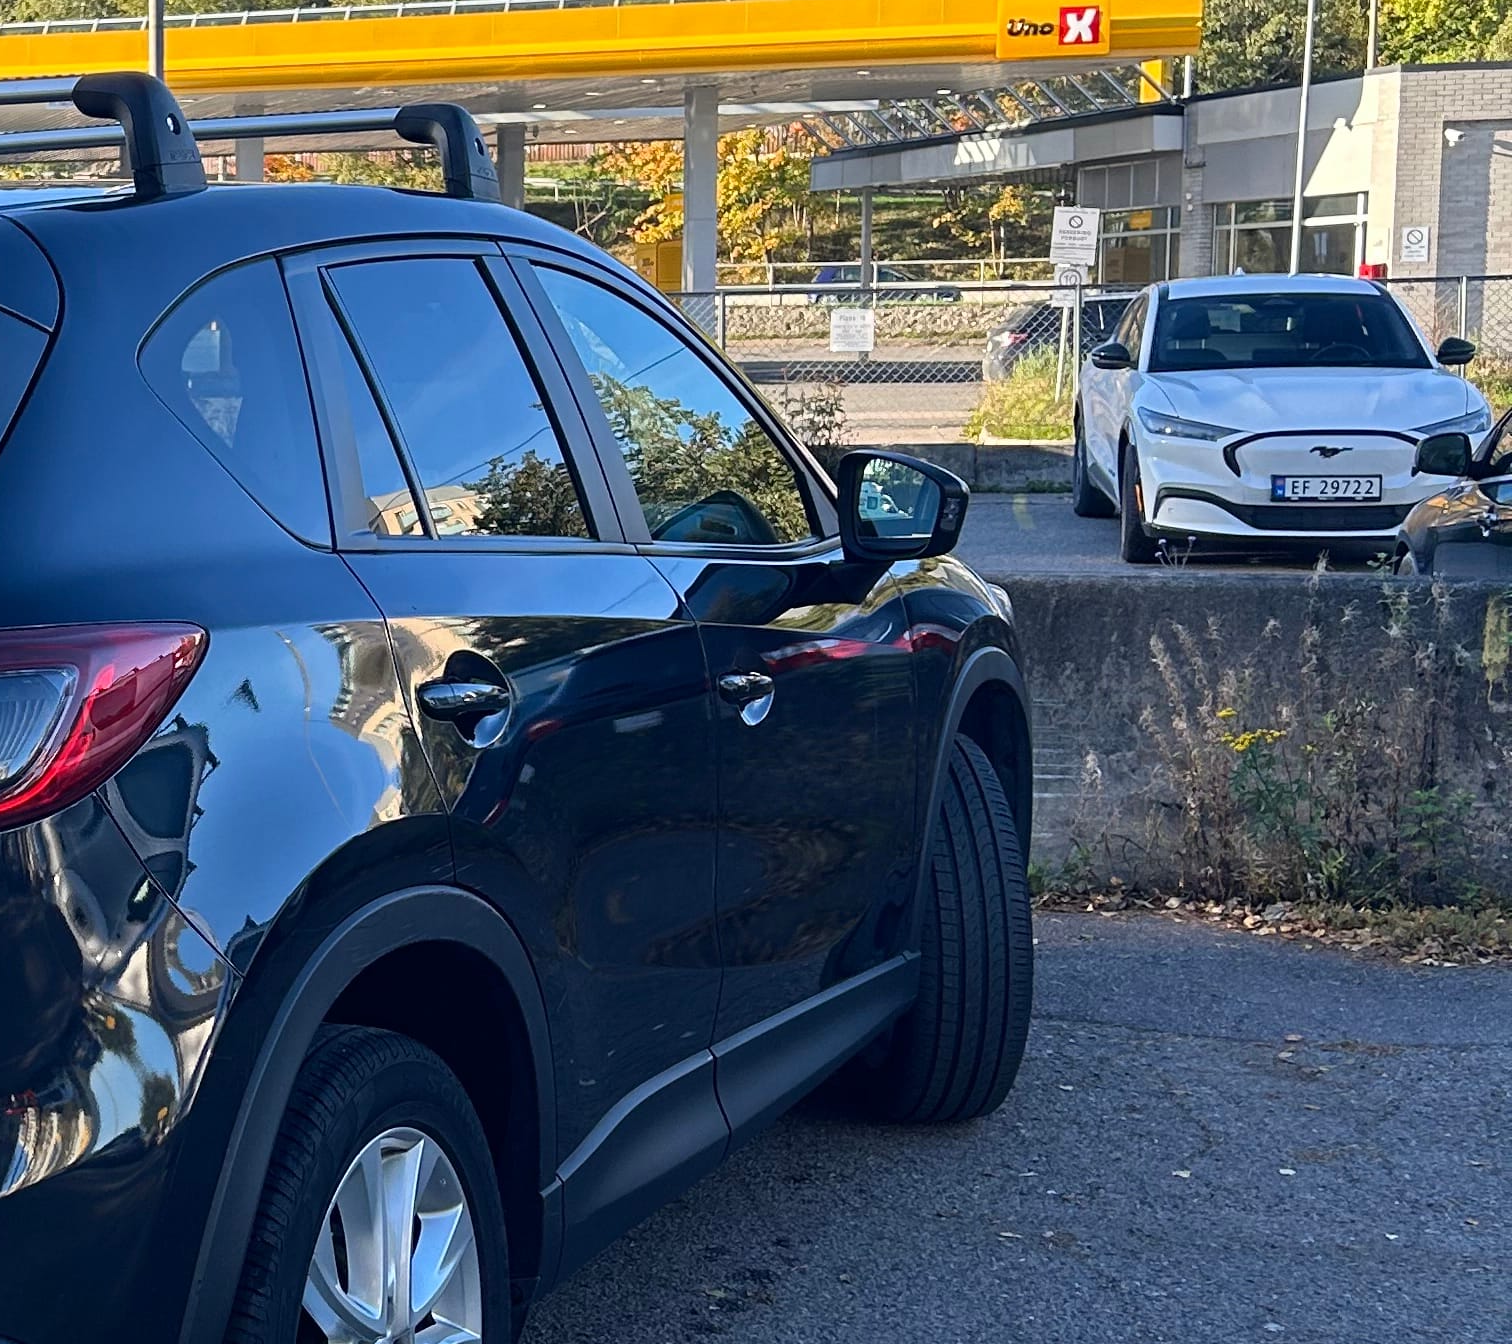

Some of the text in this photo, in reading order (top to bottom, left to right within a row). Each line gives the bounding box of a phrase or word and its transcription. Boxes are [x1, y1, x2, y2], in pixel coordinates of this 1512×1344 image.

[1007, 8, 1096, 43] Uno X
[1291, 480, 1374, 494] EF 29722
